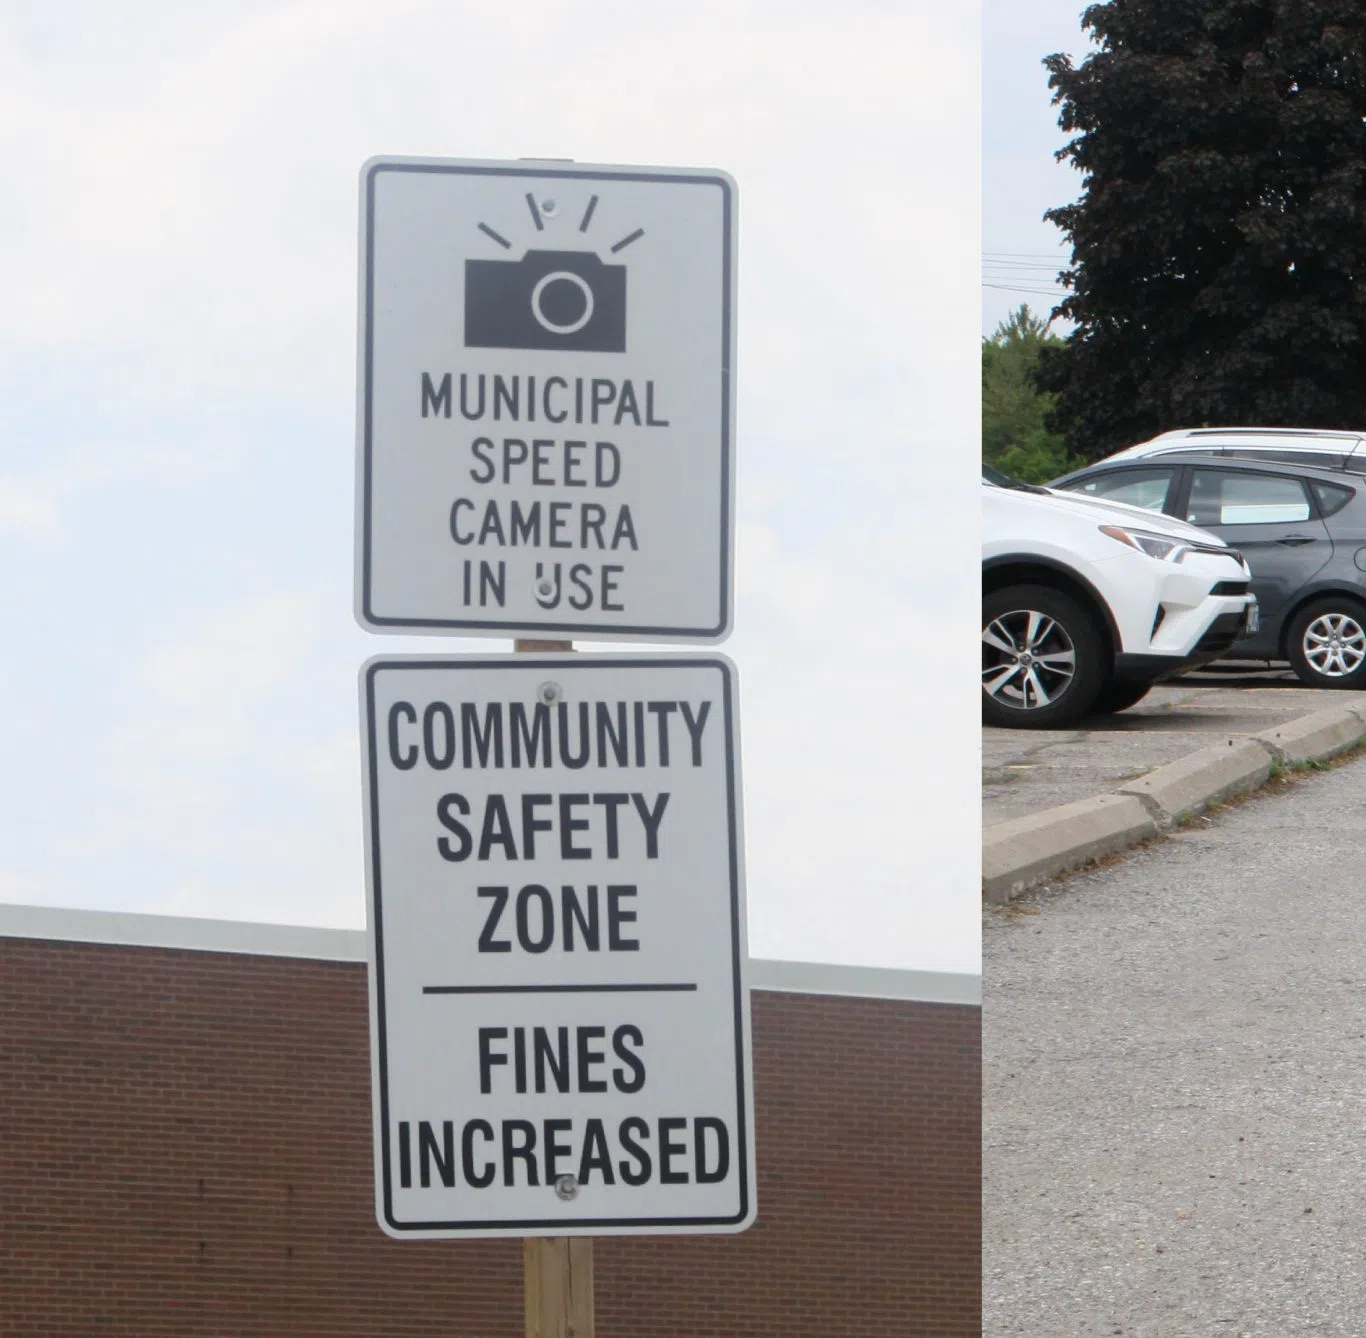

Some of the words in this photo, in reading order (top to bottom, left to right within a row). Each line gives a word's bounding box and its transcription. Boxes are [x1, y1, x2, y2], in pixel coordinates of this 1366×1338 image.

[421, 371, 669, 427] MUNICIPAL
[469, 436, 622, 489] SPEED
[449, 498, 639, 551] CAMERA
[463, 560, 506, 608] IN
[536, 562, 625, 612] USE
[388, 700, 712, 772] COMMUNITY
[436, 792, 670, 863] SAFETY
[477, 884, 640, 954] ZONE
[478, 1024, 646, 1095] FINES
[398, 1116, 730, 1190] INCREASED
